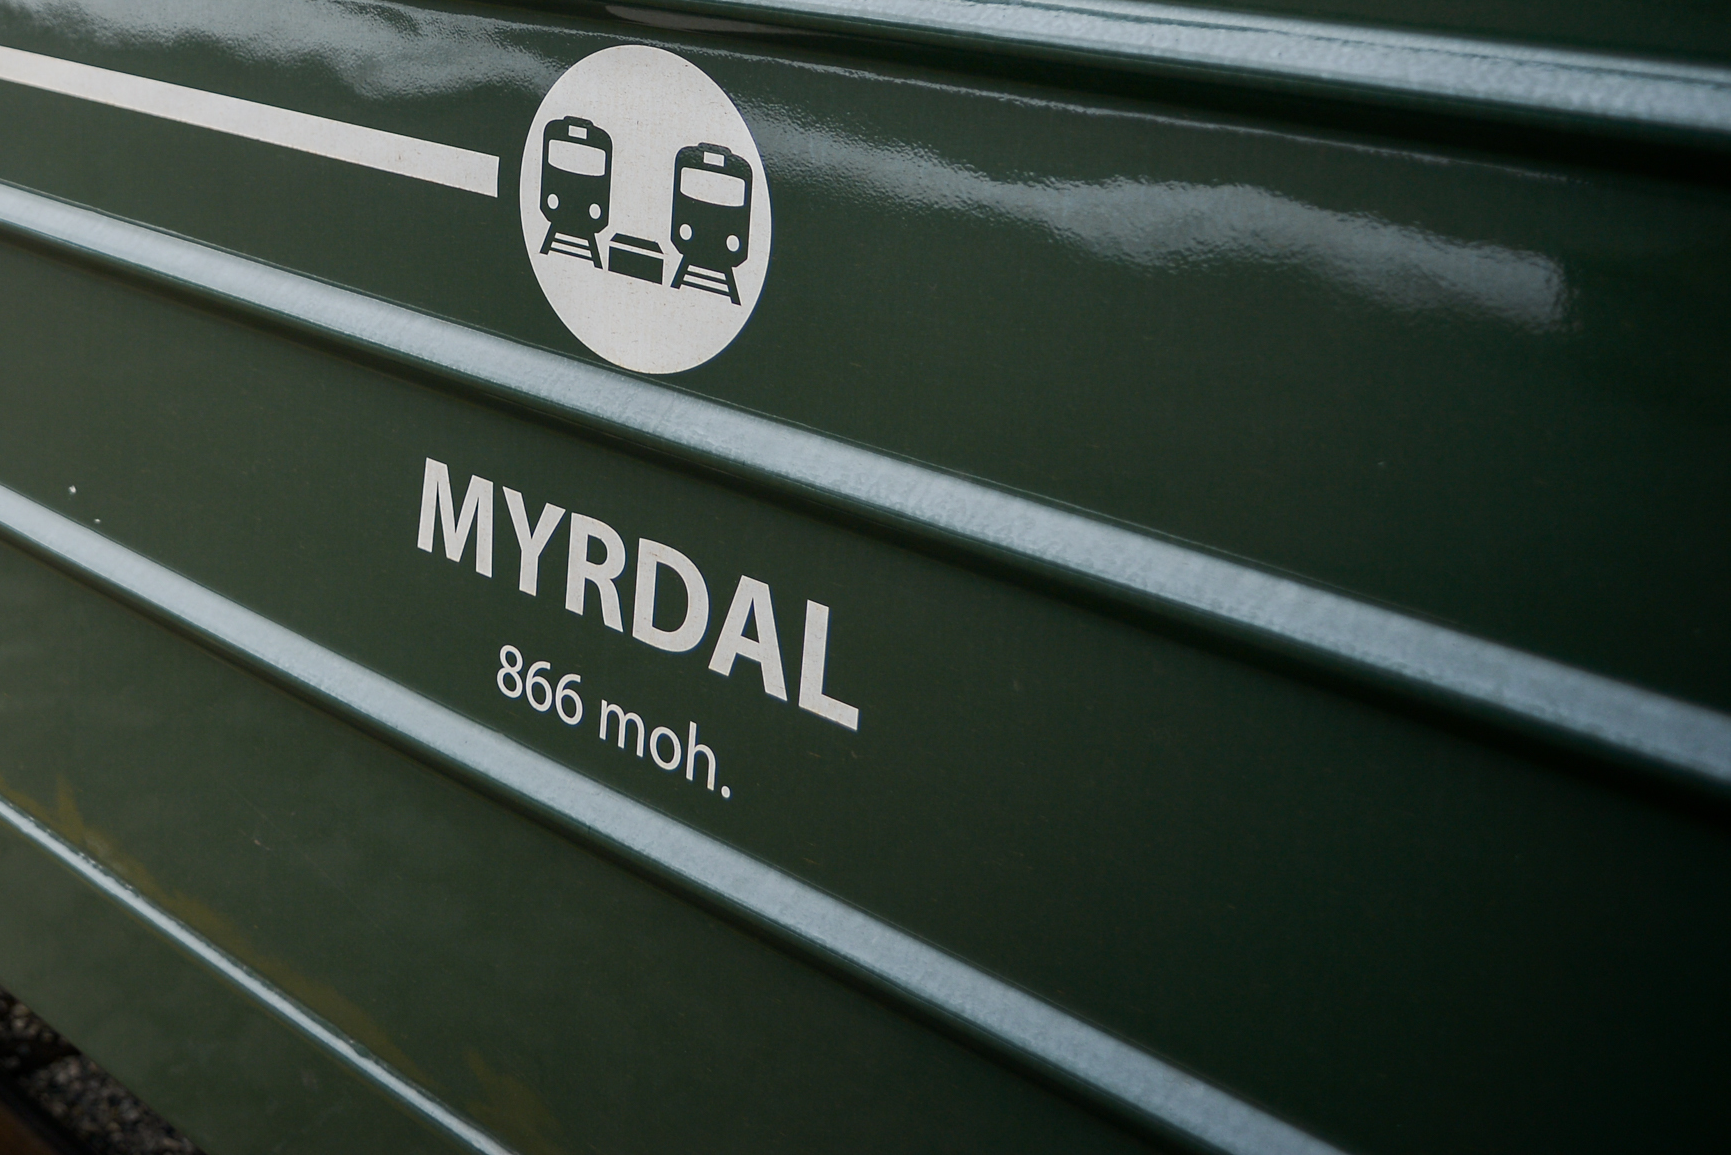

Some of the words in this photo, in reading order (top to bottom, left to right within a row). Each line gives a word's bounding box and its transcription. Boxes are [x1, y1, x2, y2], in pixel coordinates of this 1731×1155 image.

[417, 457, 859, 731] MYRDAL
[496, 644, 583, 725] 866
[598, 699, 731, 798] moh.
